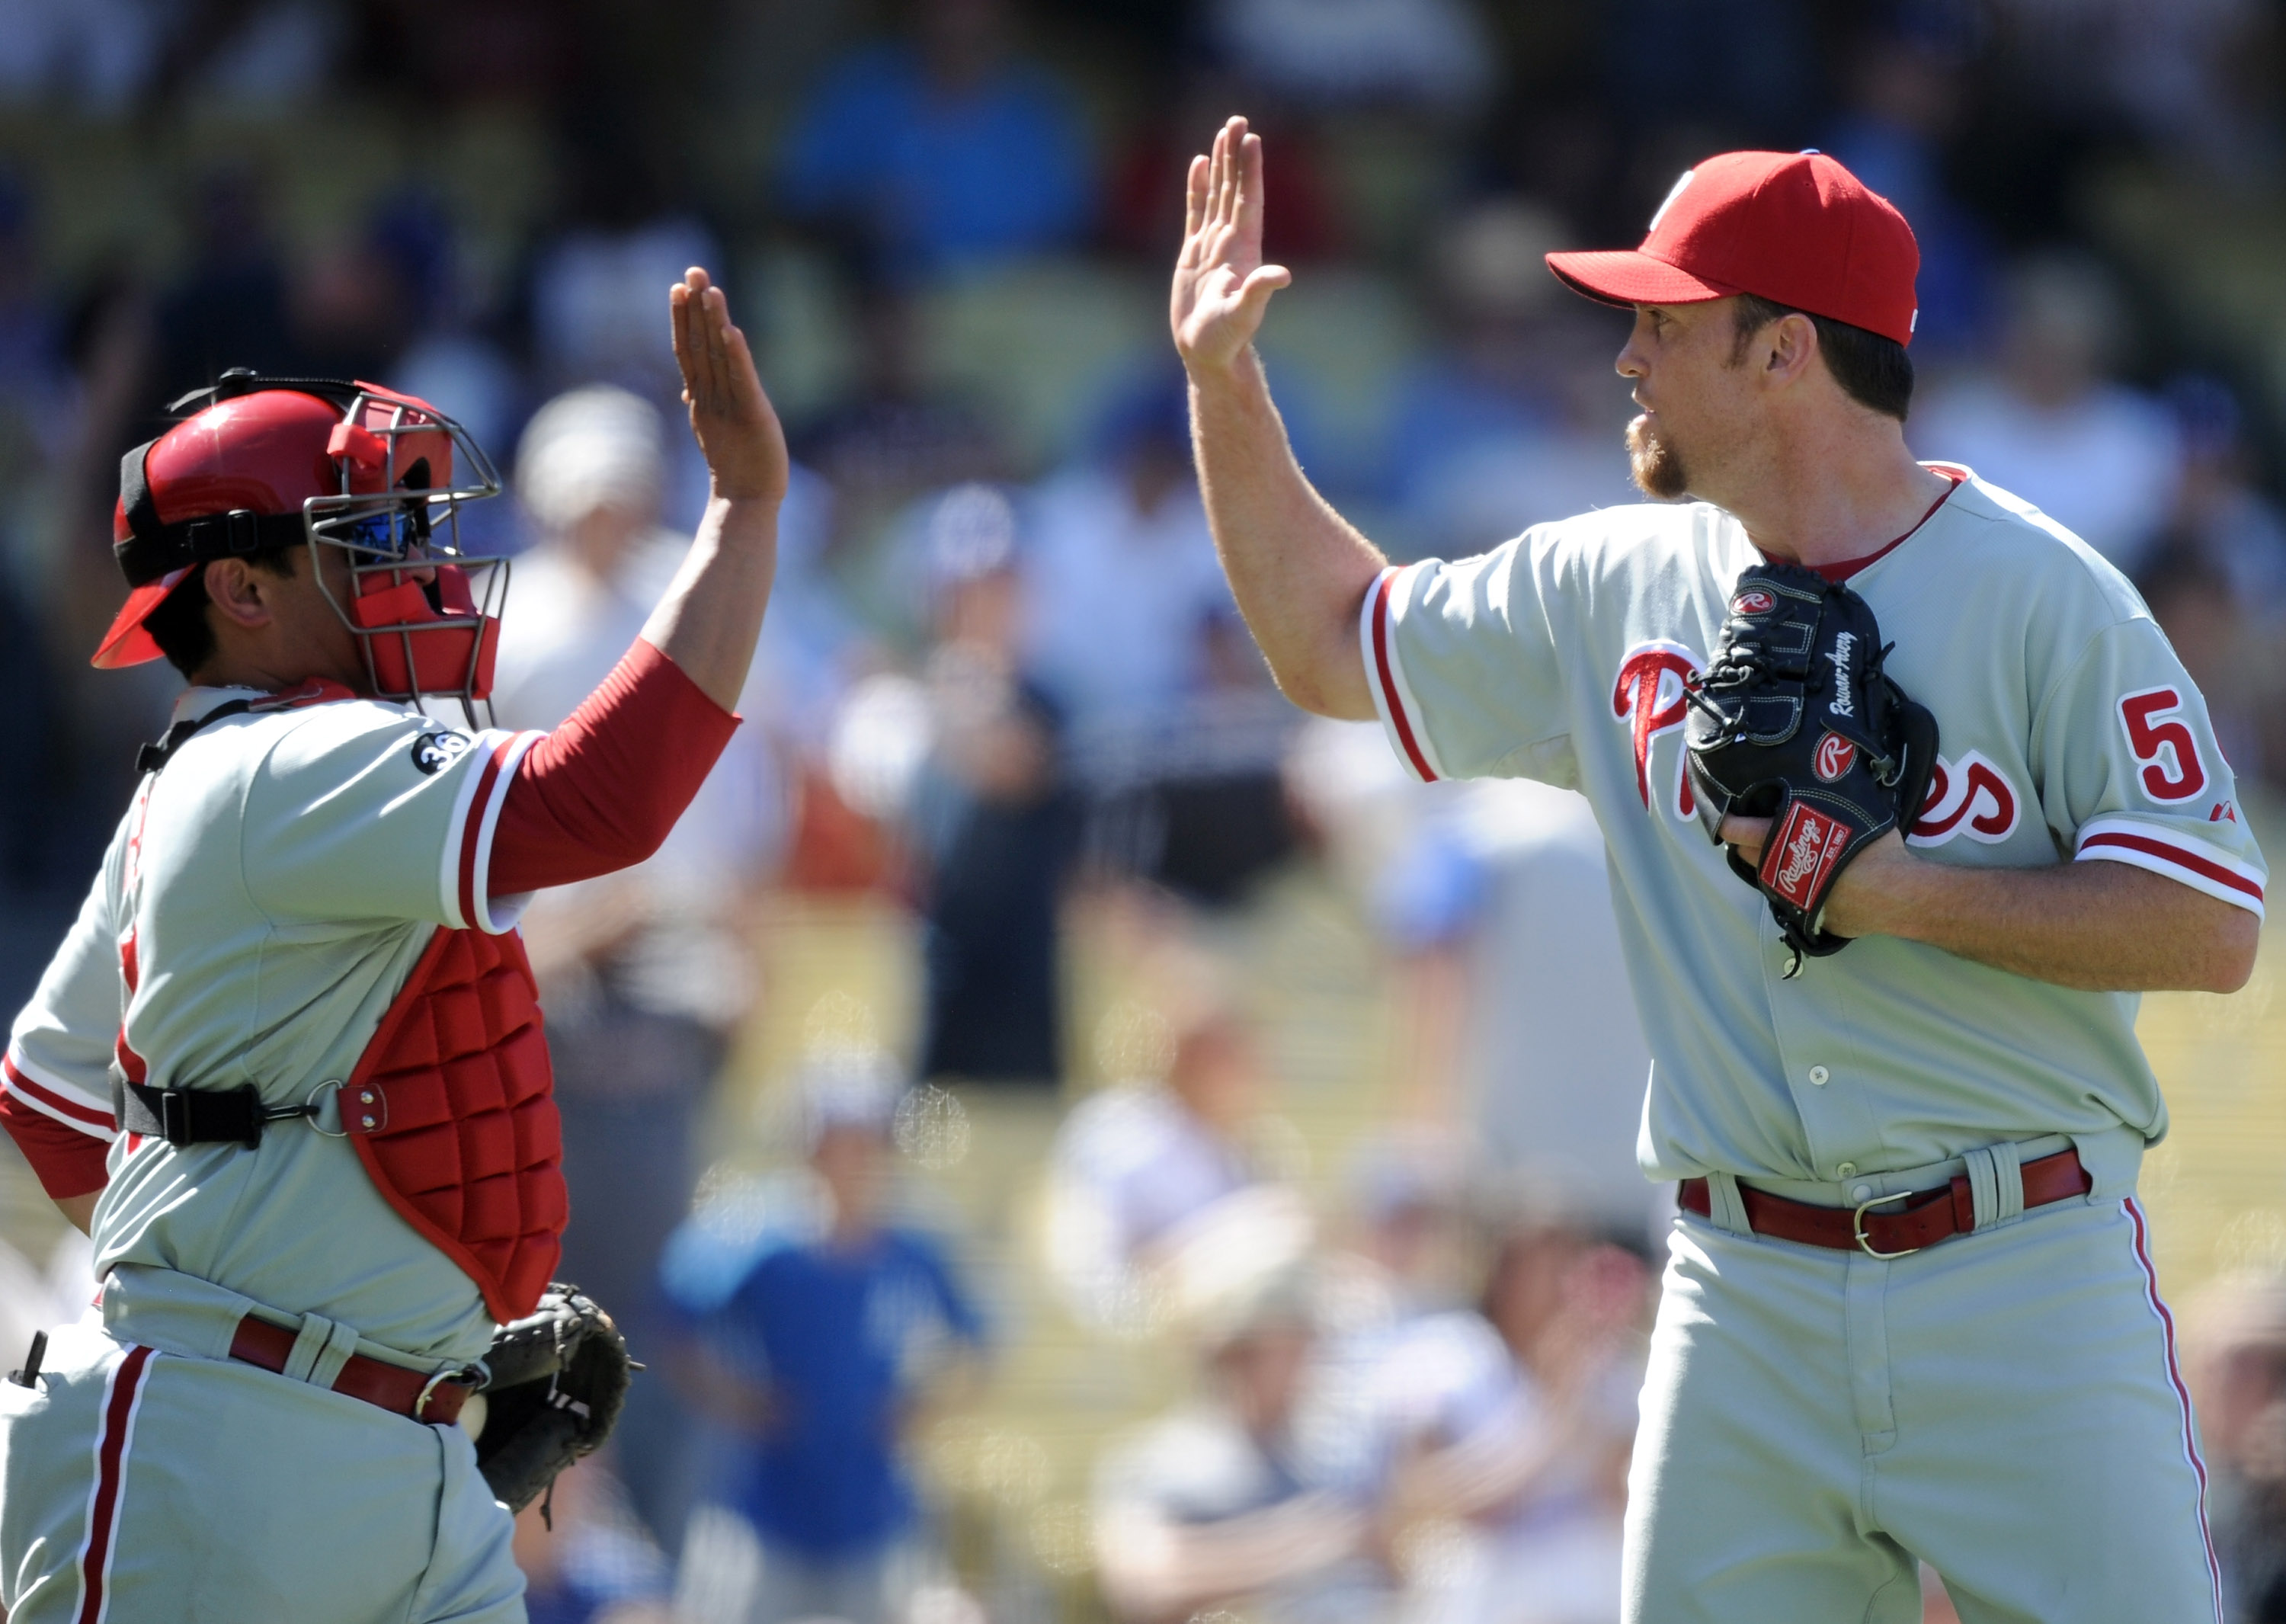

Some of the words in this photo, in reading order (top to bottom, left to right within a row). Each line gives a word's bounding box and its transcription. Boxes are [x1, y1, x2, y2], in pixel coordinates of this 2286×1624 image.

[420, 734, 469, 770] 36
[1820, 735, 1854, 779] R
[2118, 686, 2208, 805] 5
[1779, 818, 1820, 894] Rawlings
